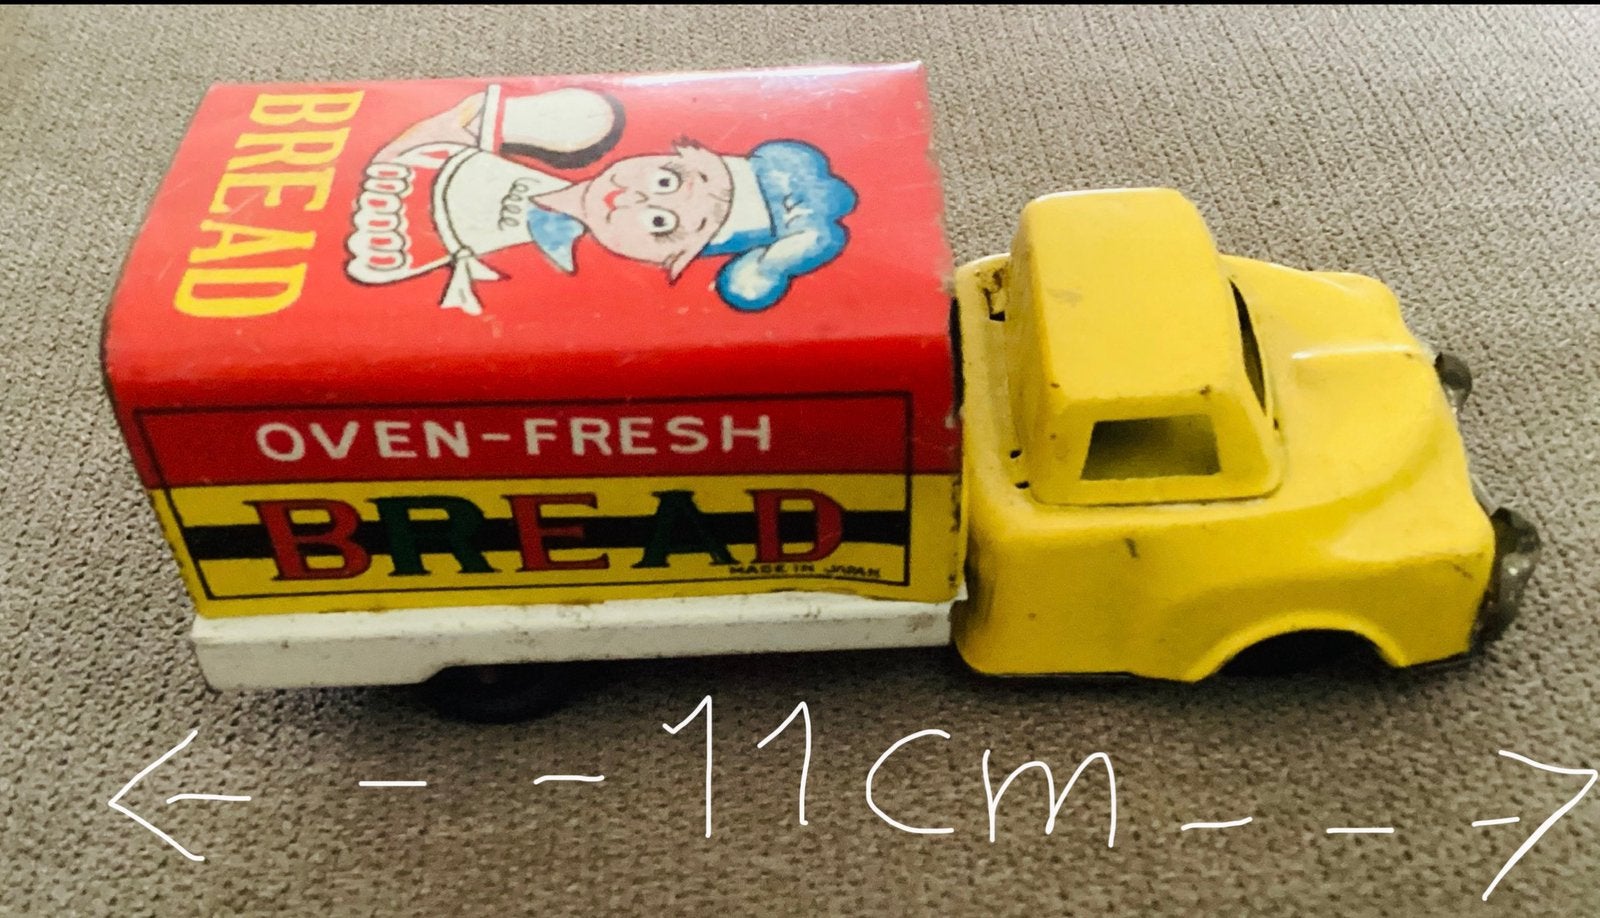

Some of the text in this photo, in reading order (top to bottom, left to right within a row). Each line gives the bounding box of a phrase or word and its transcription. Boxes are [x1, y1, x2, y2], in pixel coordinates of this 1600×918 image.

[174, 90, 366, 319] BREAD
[256, 413, 772, 462] OVEN-FRESH
[244, 487, 845, 581] BREAD
[729, 564, 882, 578] MADE IN JAPAN
